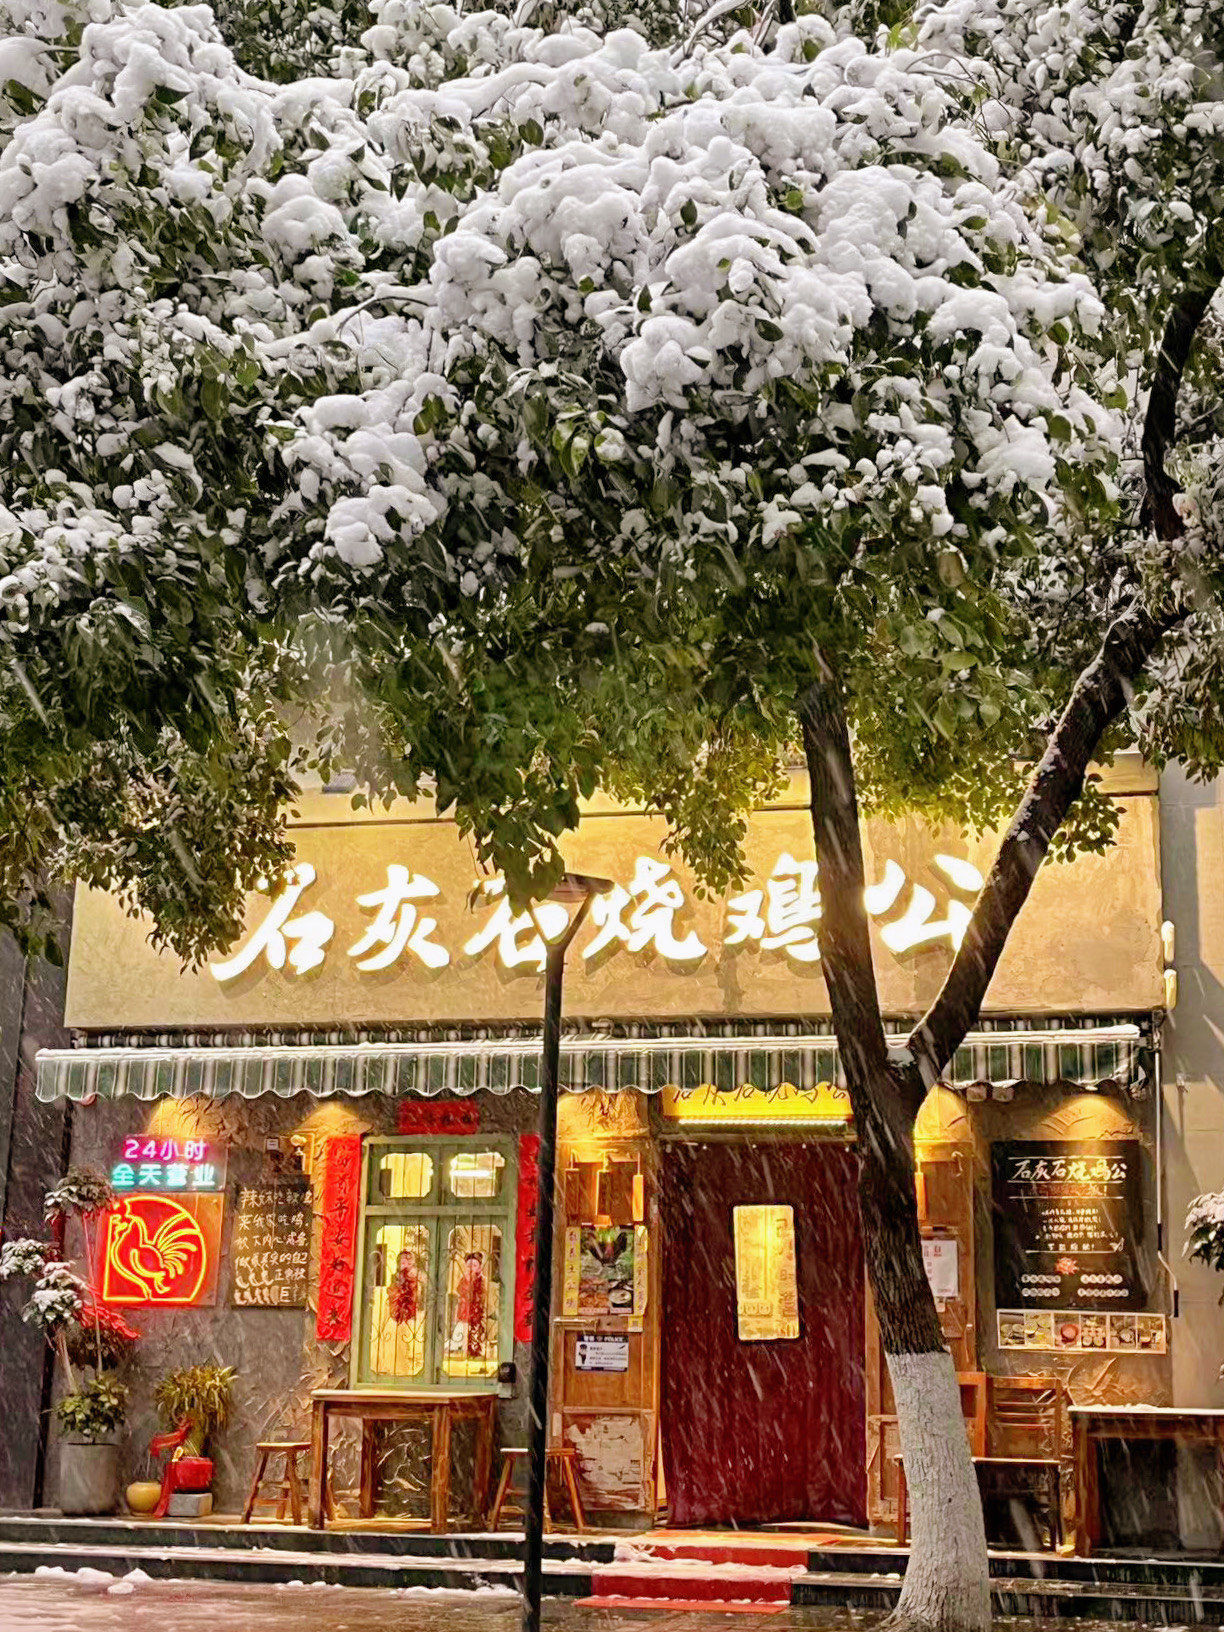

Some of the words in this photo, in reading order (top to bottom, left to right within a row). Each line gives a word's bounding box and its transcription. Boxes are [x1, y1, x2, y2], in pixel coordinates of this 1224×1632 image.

[124, 1138, 208, 1161] 24小时
[111, 1162, 216, 1187] 全天营业
[1012, 1158, 1128, 1181] 石灰石烧鸡公
